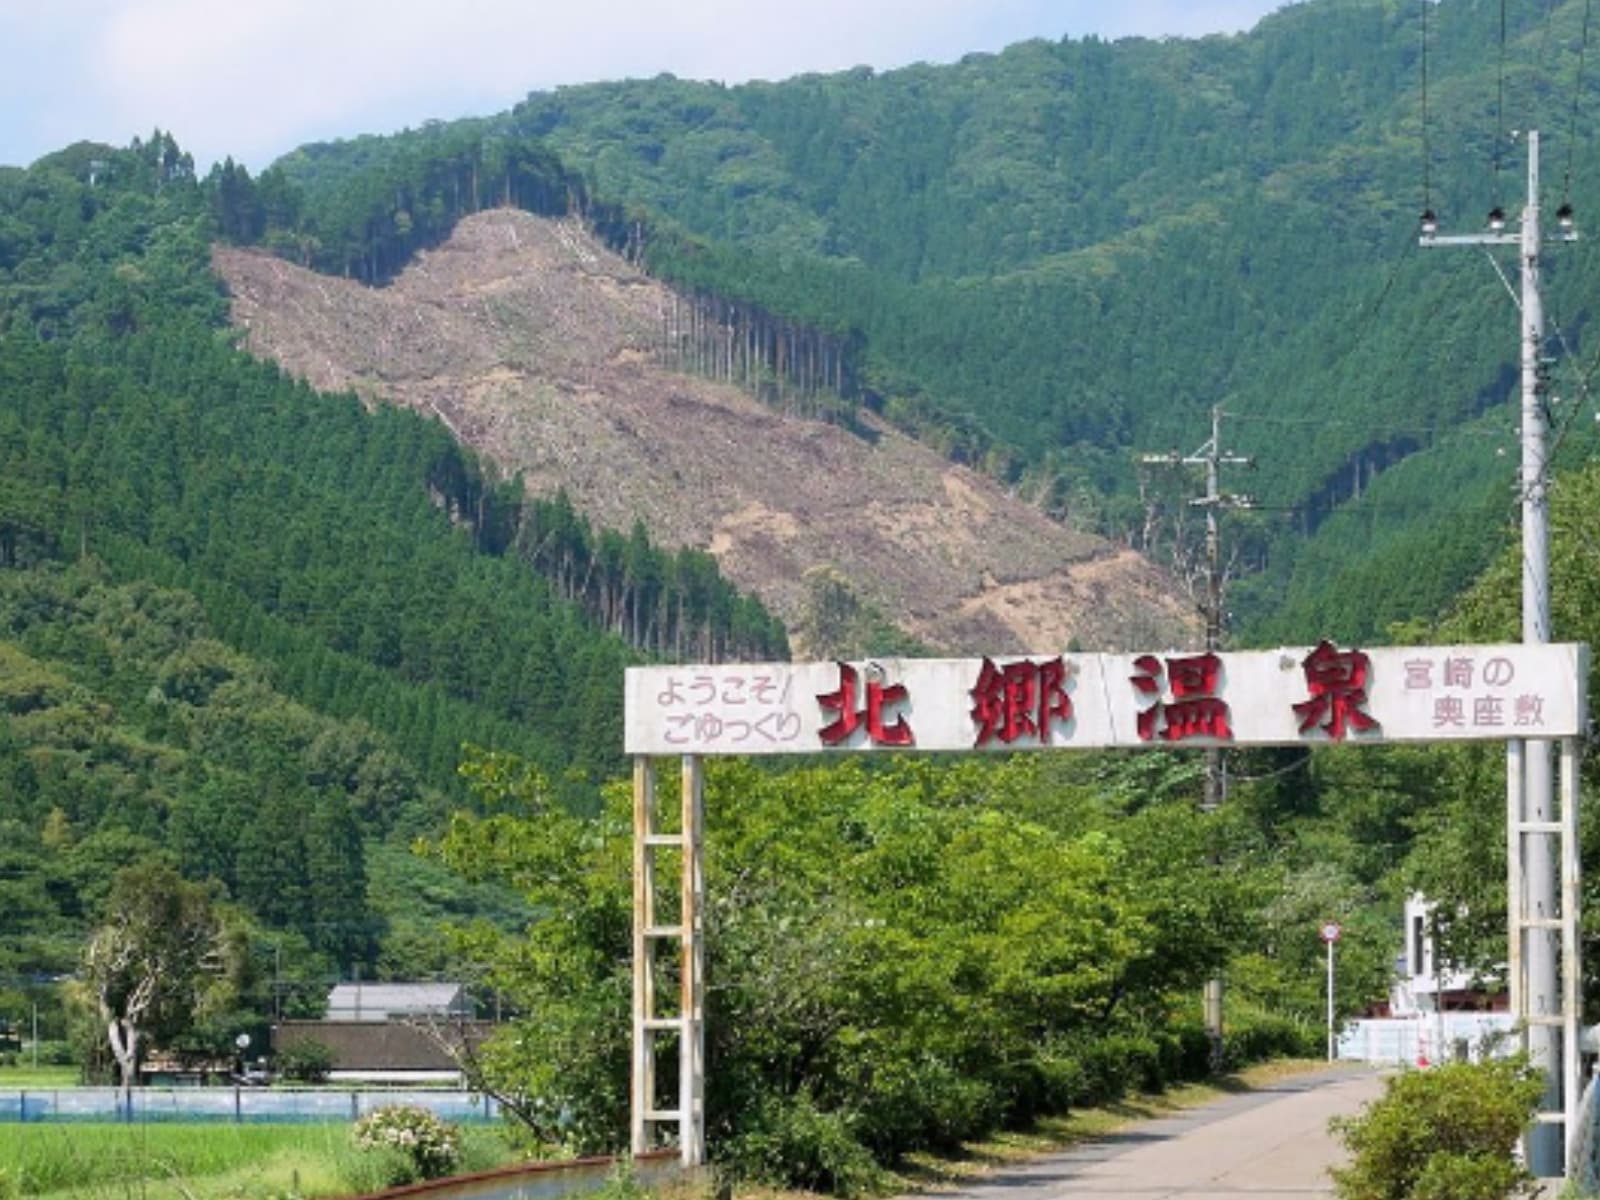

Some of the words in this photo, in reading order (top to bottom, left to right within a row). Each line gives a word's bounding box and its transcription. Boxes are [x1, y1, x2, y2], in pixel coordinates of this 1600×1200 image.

[1404, 656, 1515, 689] 宮崎の
[817, 640, 1381, 747] 北郷温泉
[663, 711, 801, 743] ごゆっくり
[1433, 695, 1545, 727] 奥座敷
